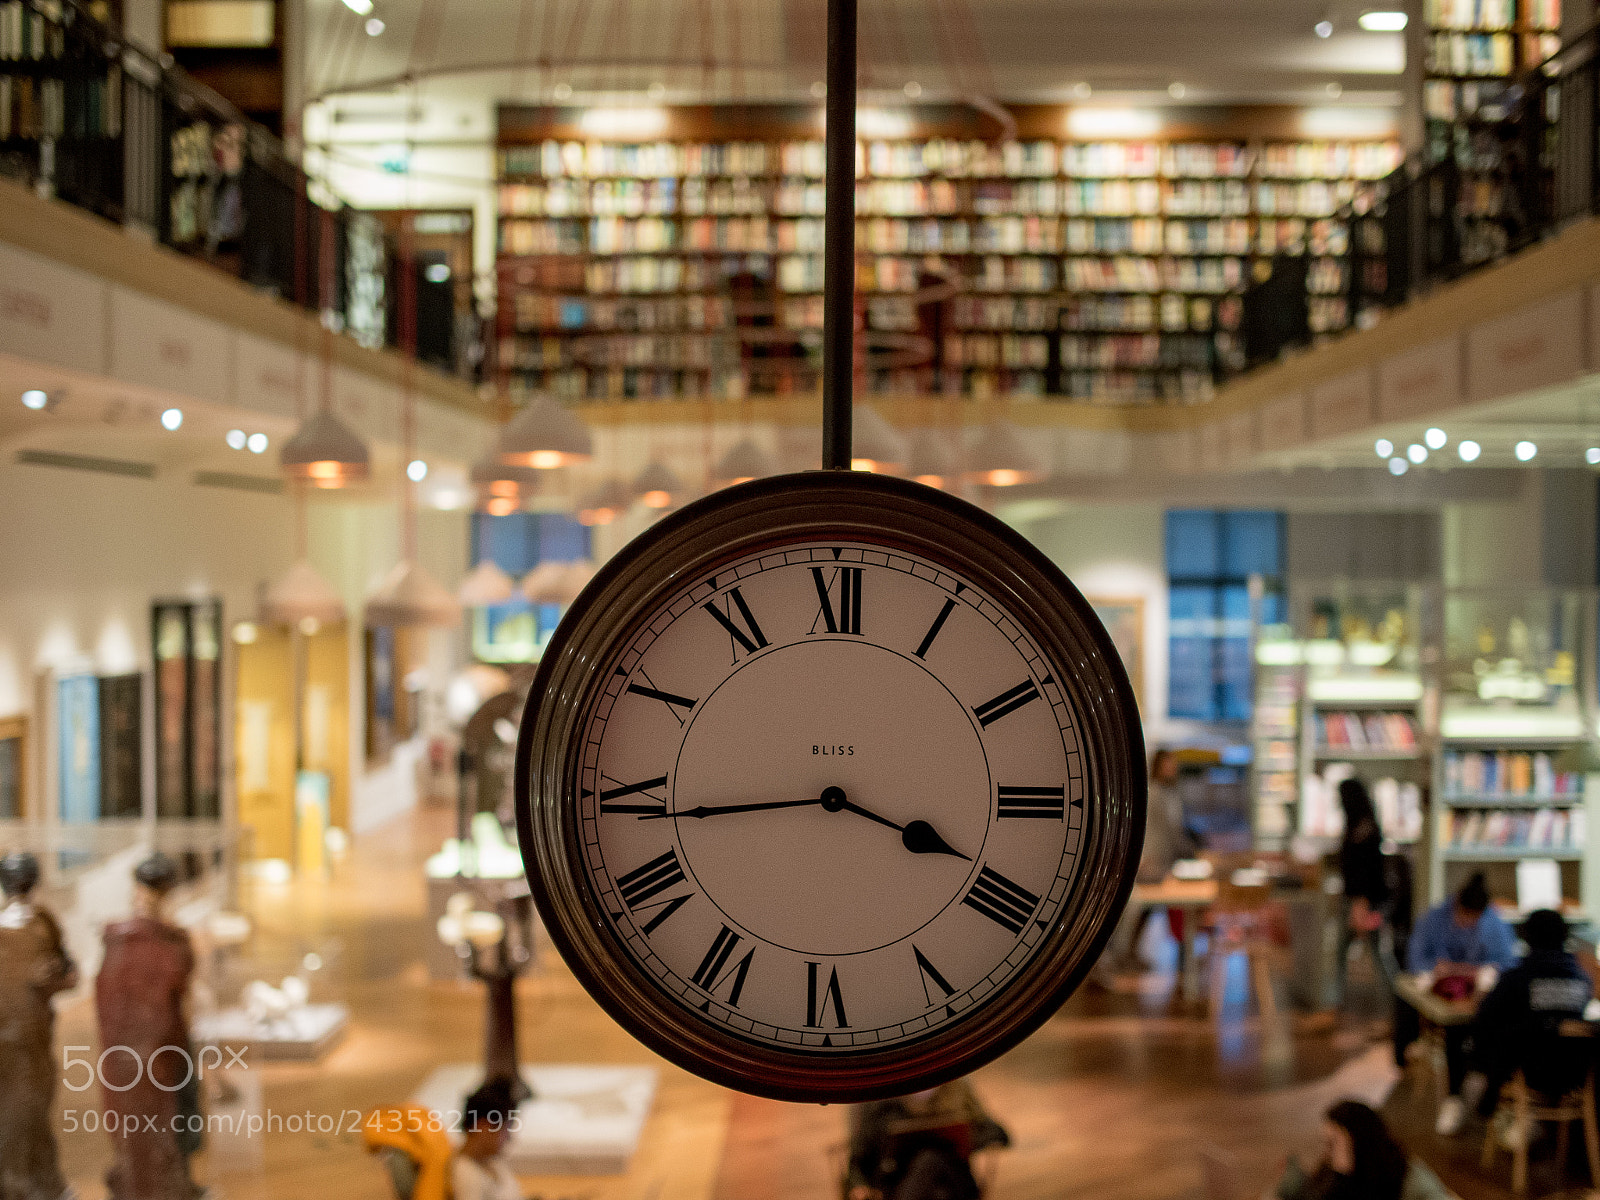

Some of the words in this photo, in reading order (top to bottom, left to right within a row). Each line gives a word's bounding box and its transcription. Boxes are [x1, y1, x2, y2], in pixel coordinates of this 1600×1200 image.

[700, 586, 772, 665] XI
[806, 566, 867, 636] XII
[625, 665, 699, 729] X
[970, 675, 1043, 731] II
[812, 744, 855, 756] BLISS
[600, 770, 668, 818] IX
[996, 783, 1065, 824] III
[614, 845, 695, 938] VIII
[959, 861, 1043, 937] IIII
[687, 922, 757, 1010] VII
[802, 961, 852, 1029] VI
[912, 943, 960, 1009] V
